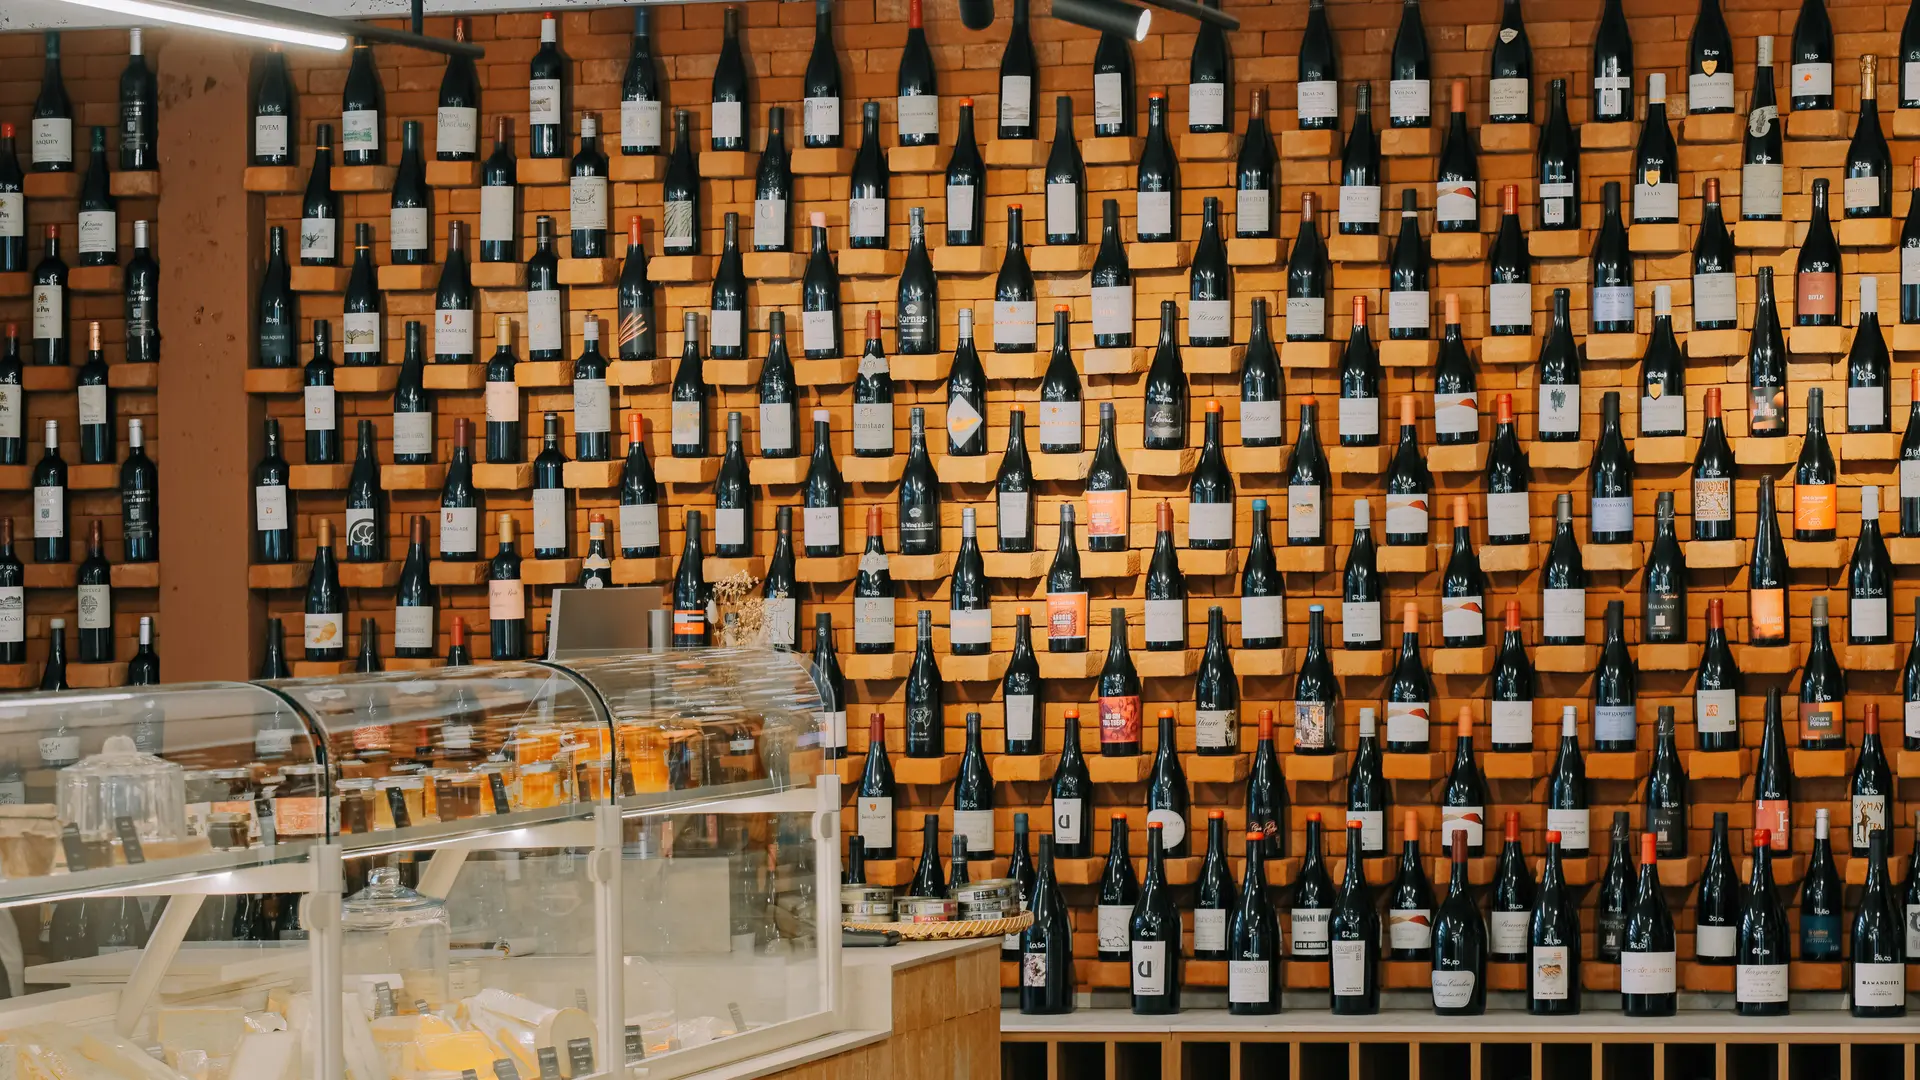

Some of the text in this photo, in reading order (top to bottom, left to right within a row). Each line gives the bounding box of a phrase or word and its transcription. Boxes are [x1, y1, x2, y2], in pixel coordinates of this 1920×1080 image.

[1197, 312, 1224, 322] Fleurie
[1243, 411, 1271, 422] Fleurie
[1597, 710, 1633, 719] Bourgogne
